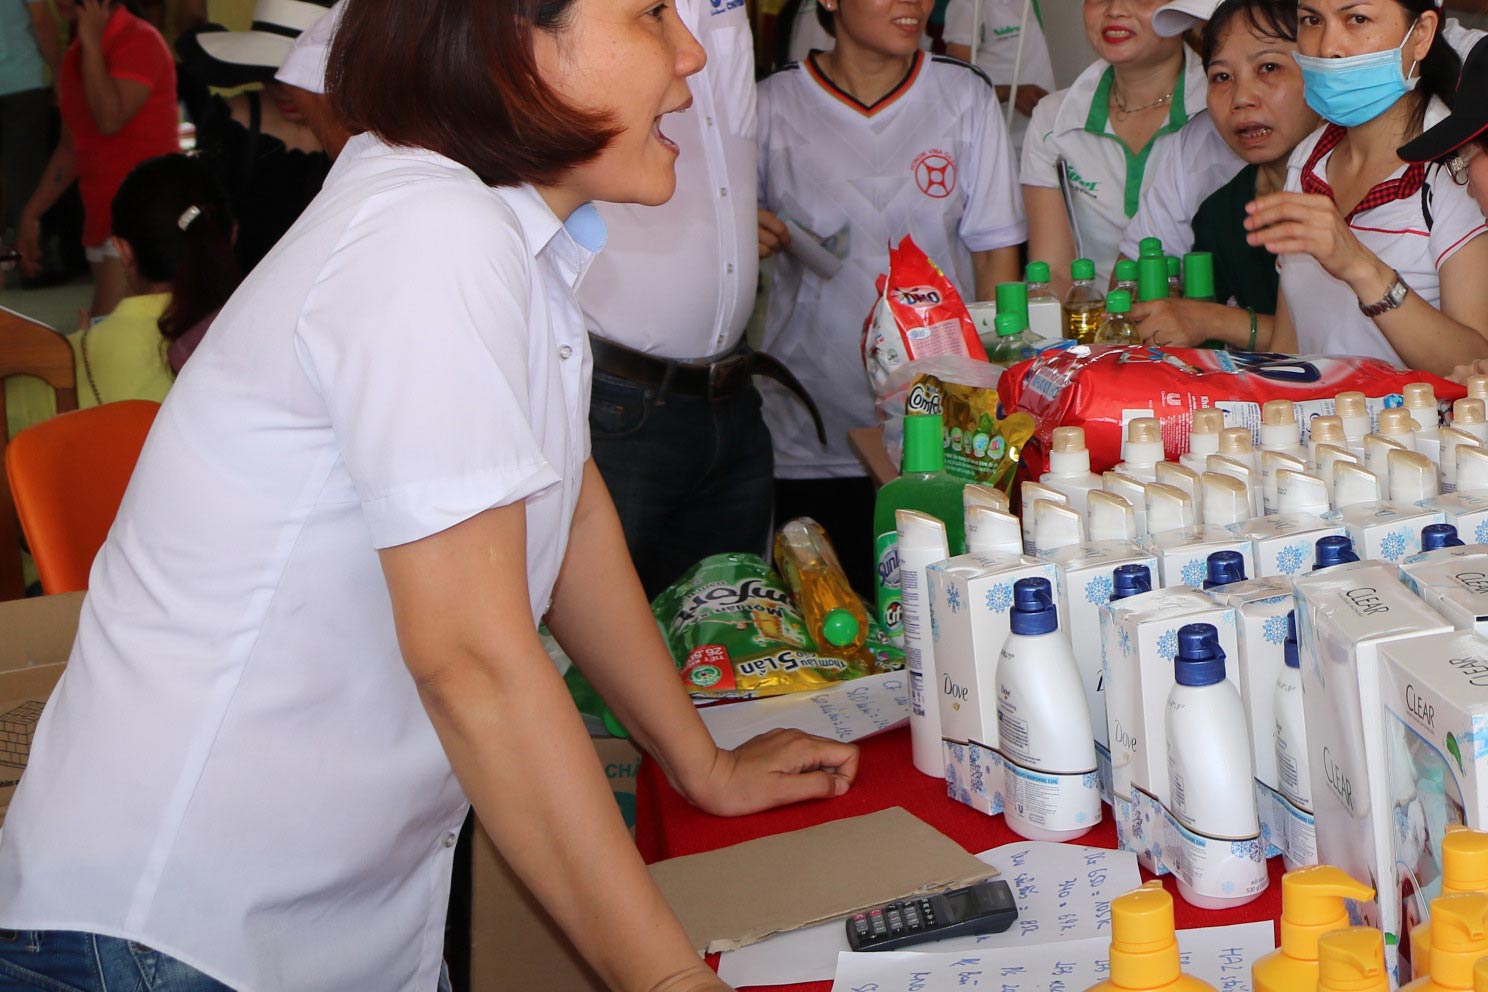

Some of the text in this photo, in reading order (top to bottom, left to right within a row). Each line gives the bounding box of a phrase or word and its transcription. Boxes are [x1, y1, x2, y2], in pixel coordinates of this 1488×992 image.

[1345, 587, 1390, 616] CLEAR
[739, 650, 799, 677] 5 Lần
[943, 673, 969, 702] Dove
[1405, 684, 1435, 730] CLEAR
[1114, 719, 1137, 753] Dove
[1323, 746, 1354, 811] CLEAR
